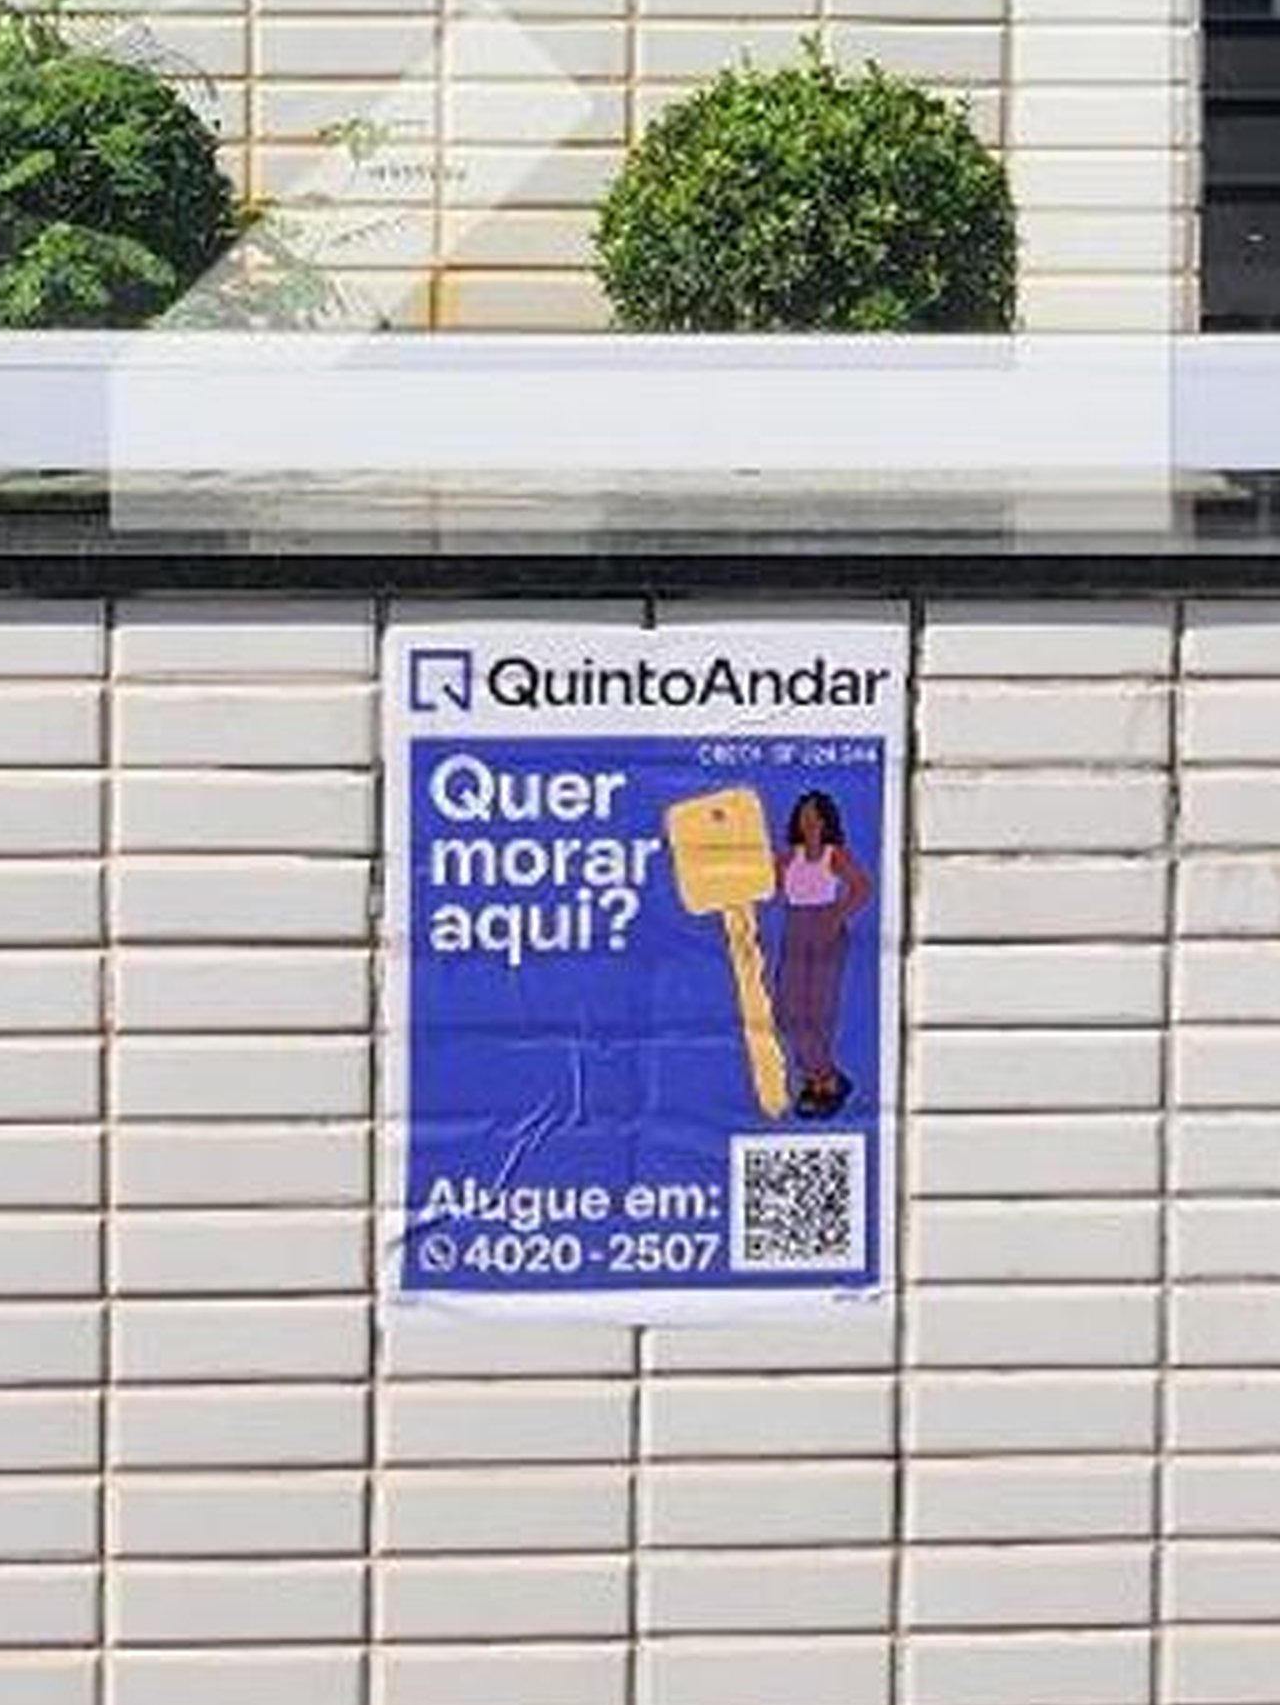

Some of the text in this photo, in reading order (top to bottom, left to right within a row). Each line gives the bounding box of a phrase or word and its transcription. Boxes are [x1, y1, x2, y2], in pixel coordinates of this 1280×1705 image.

[487, 656, 891, 710] QuintoAndar
[429, 754, 626, 822] Quer
[430, 837, 663, 886] morar
[429, 890, 640, 965] aqui?
[421, 1177, 721, 1230] Alugue em:
